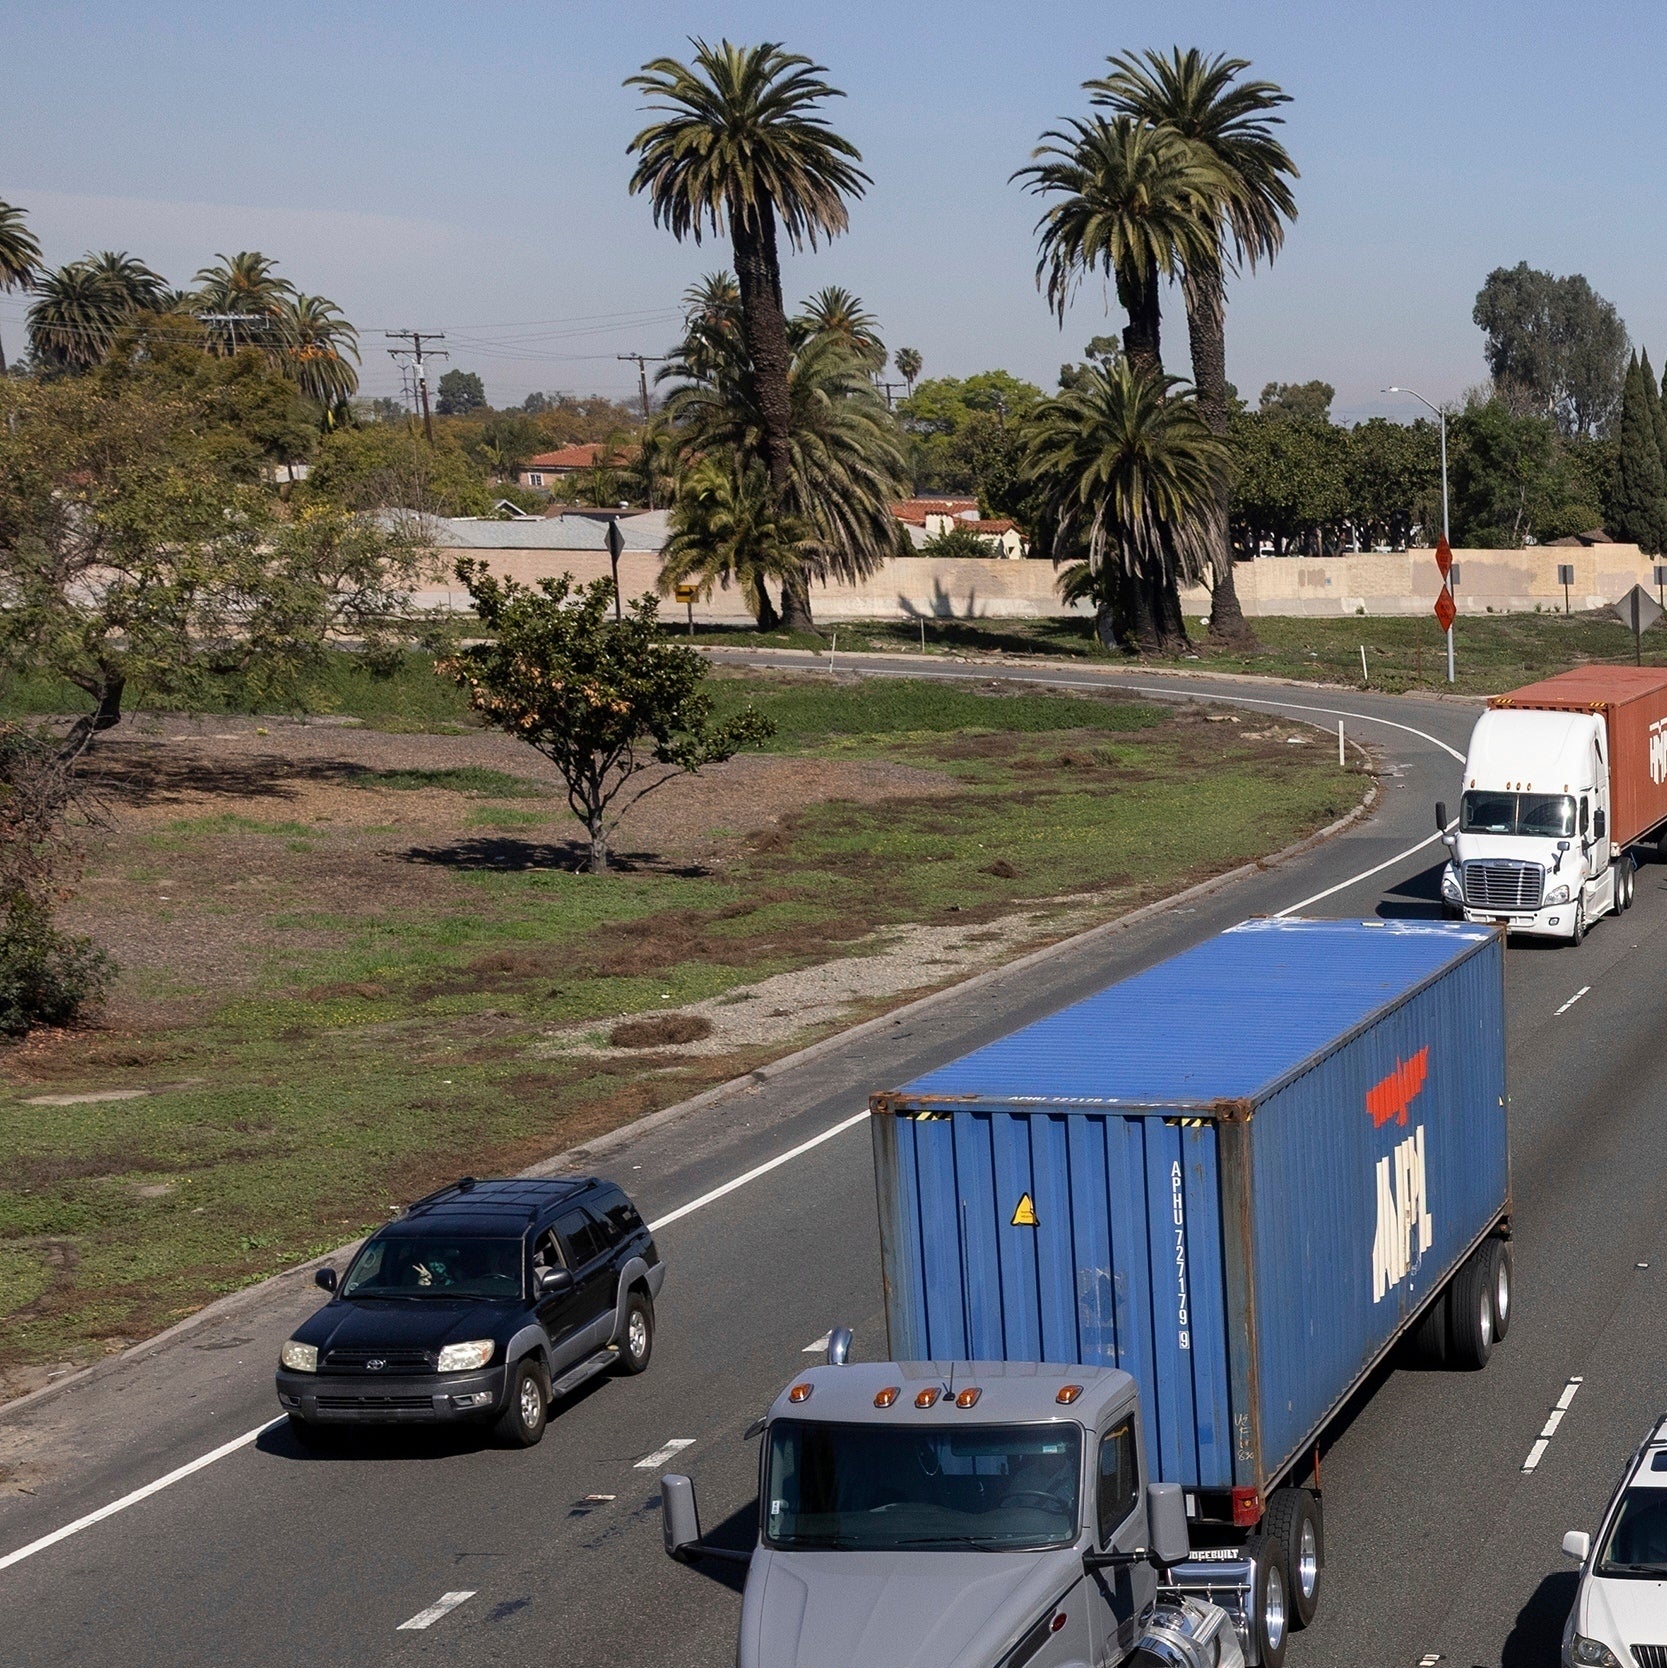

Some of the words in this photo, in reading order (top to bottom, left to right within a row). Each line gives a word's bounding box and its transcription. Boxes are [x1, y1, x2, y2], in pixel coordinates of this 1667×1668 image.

[1171, 1160, 1184, 1226] APHU
[1372, 1125, 1433, 1304] APL
[1174, 1229, 1188, 1326] 727179
[1179, 1331, 1190, 1349] 9
